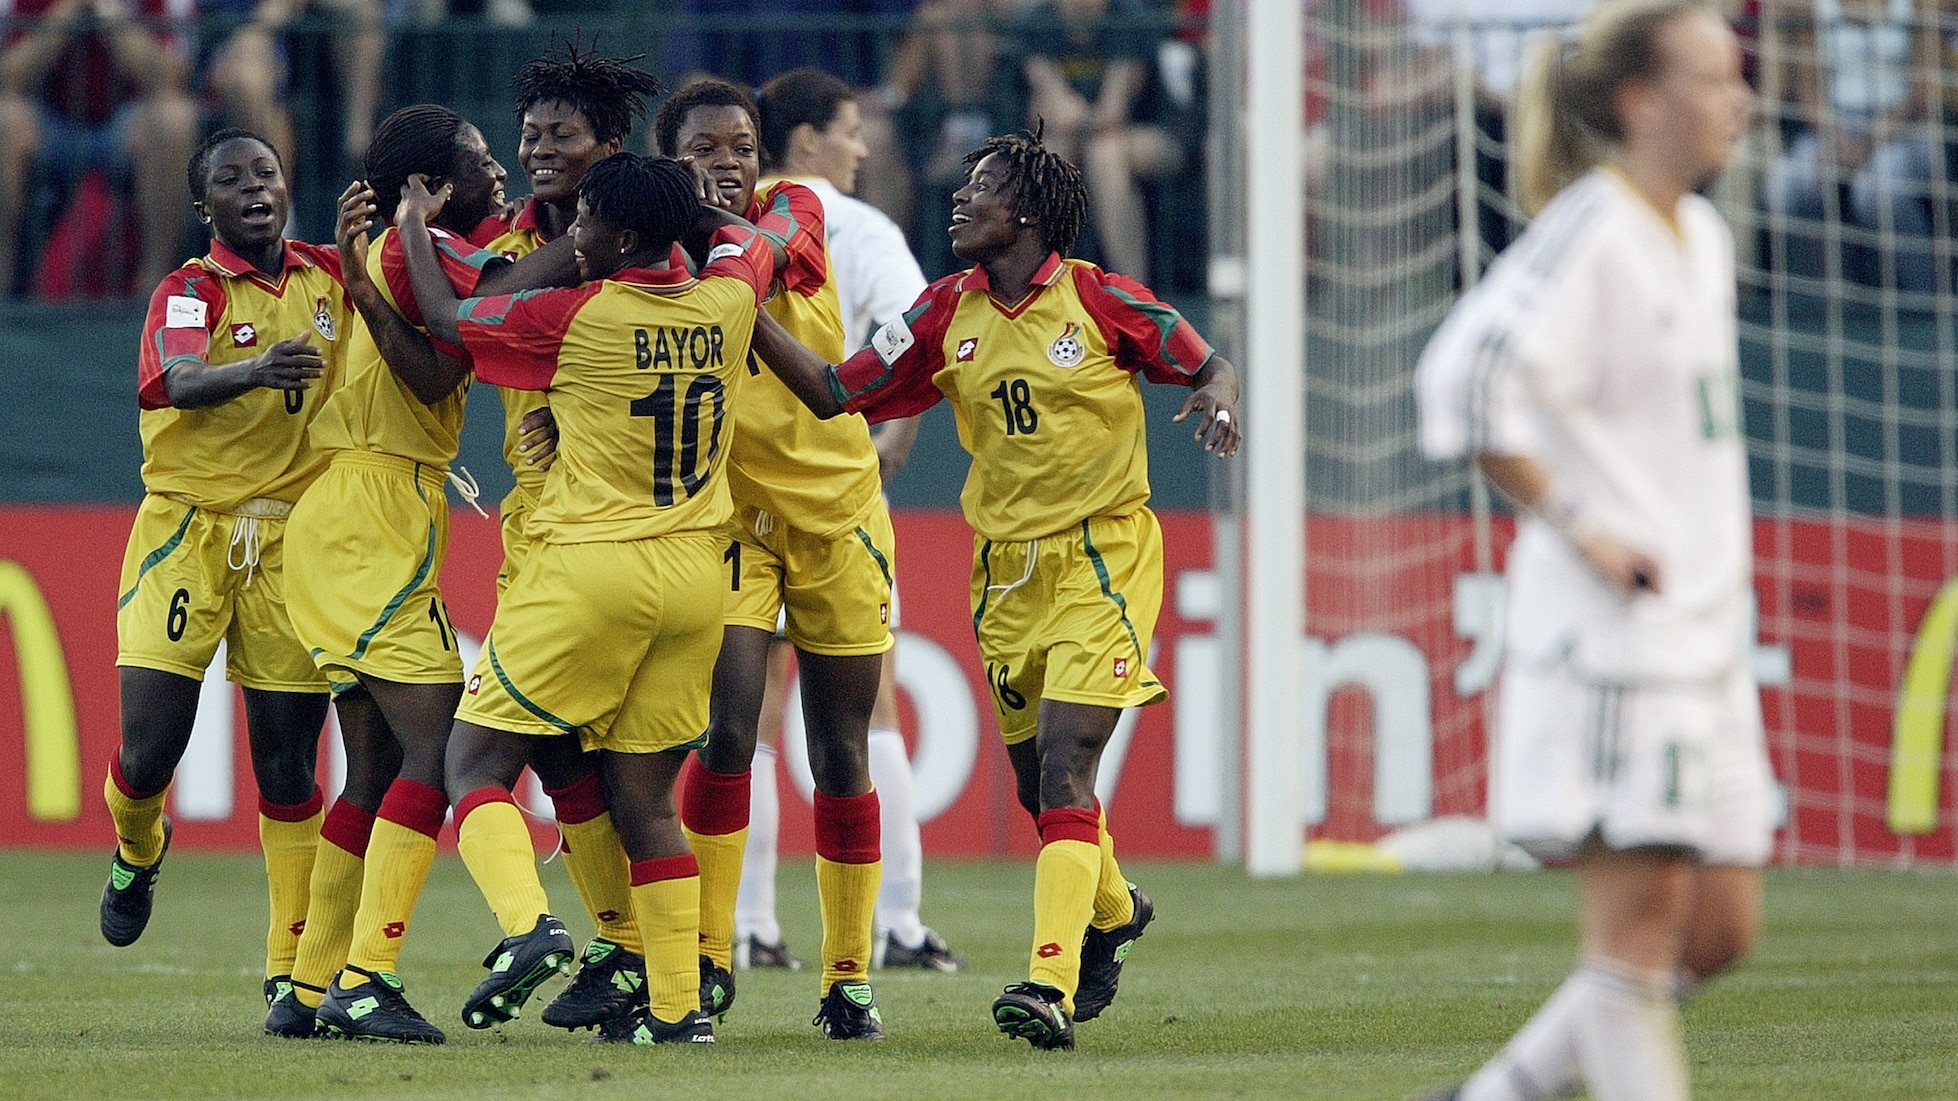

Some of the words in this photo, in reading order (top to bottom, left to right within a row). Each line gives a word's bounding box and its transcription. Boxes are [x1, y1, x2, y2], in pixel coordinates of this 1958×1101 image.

[634, 325, 724, 370] BAYOR
[991, 378, 1038, 436] 18
[630, 374, 727, 507] 10
[167, 588, 189, 642] 6
[987, 661, 1027, 717] 18
